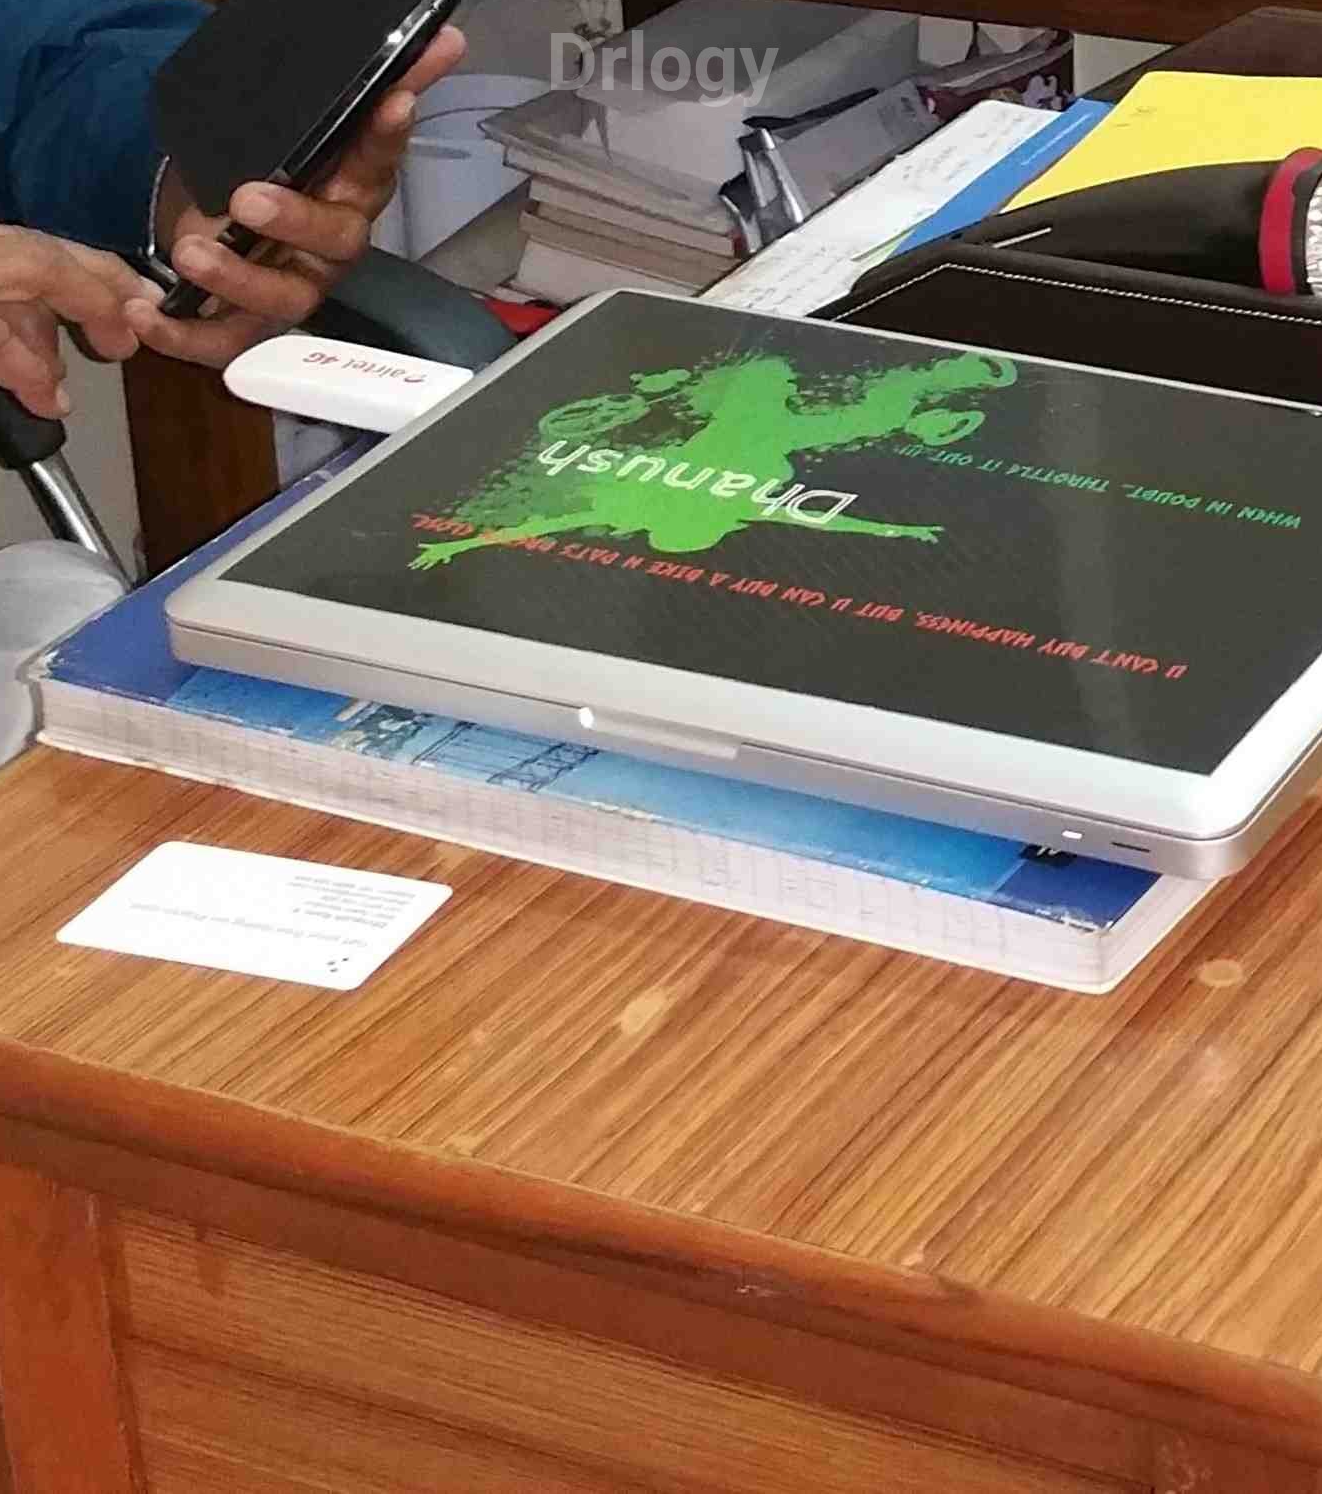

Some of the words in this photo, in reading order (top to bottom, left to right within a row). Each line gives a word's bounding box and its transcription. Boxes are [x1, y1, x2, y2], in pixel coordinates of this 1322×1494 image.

[301, 350, 340, 367] 4G
[340, 356, 407, 382] airtel
[977, 458, 1003, 474] IT
[538, 439, 860, 527] Dhanush
[1205, 500, 1232, 516] IN
[621, 553, 644, 570] N
[644, 560, 705, 583] BIKE
[709, 570, 730, 587] A
[729, 577, 778, 598] BUY
[781, 585, 826, 607] CAN
[854, 601, 905, 623] BUT
[1038, 637, 1089, 662] BUY
